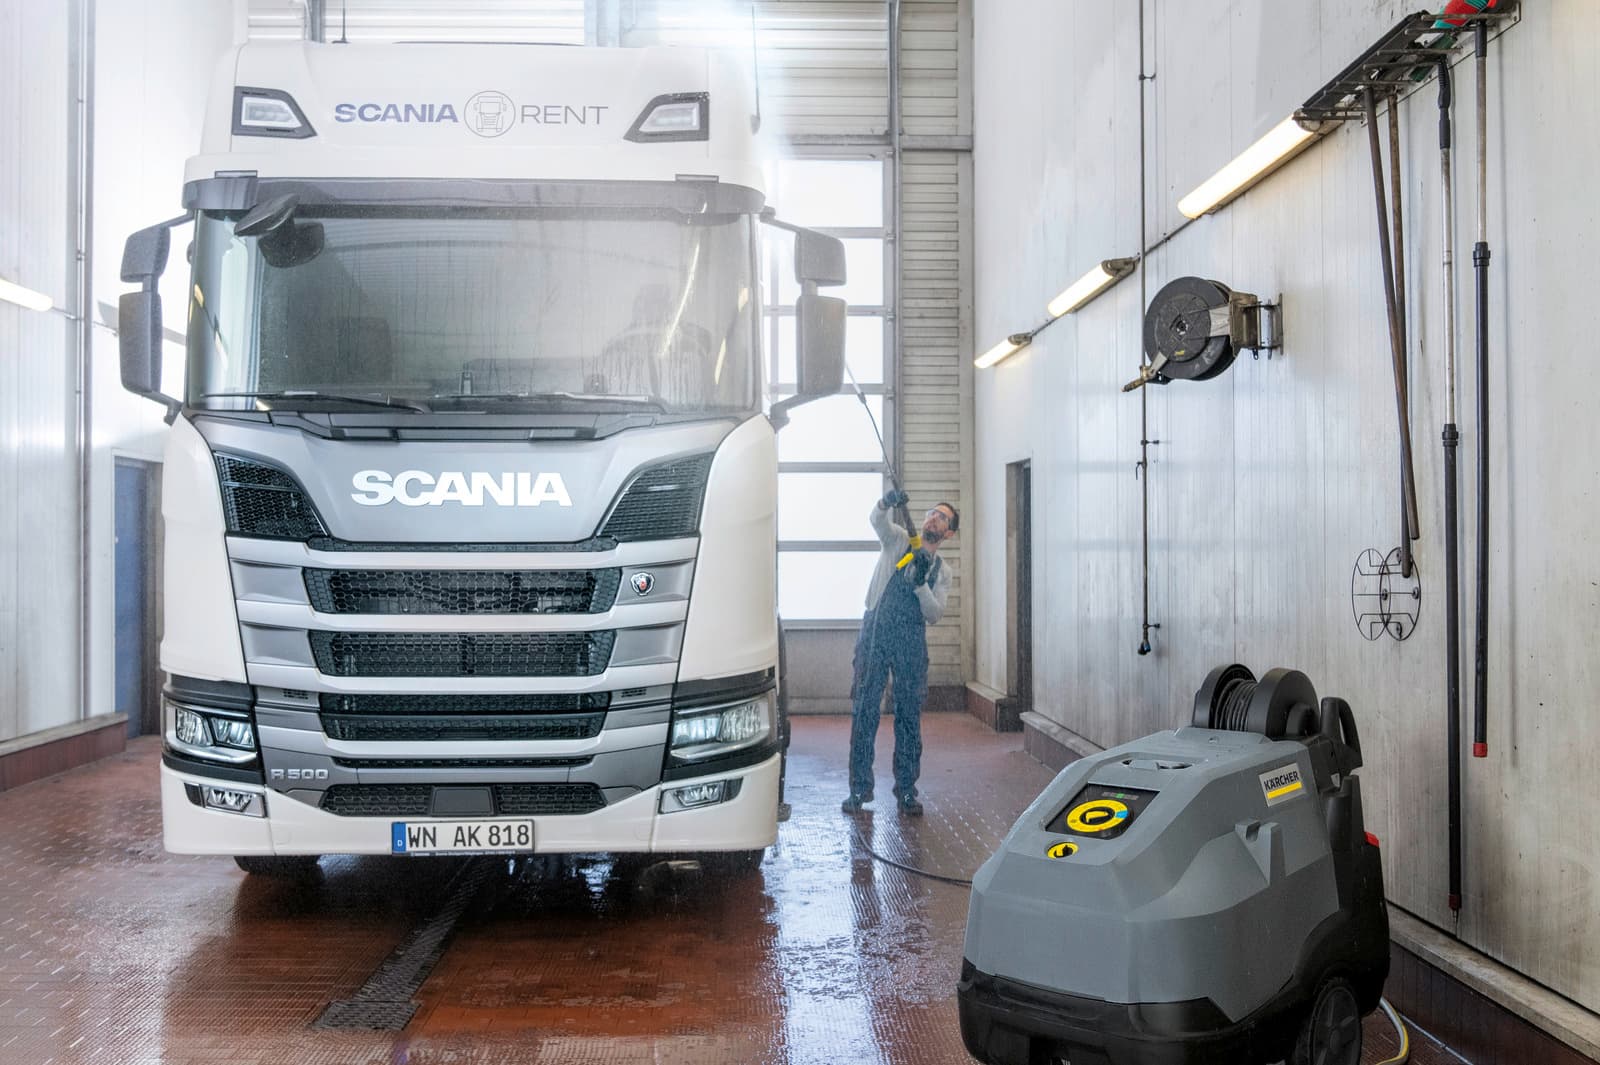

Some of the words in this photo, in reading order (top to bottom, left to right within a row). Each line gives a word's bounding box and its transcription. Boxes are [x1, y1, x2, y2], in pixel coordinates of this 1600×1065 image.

[334, 103, 459, 123] SCANIA
[520, 104, 608, 125] RENT
[351, 470, 573, 507] SCANIA
[1263, 770, 1299, 790] KÄRCHER
[407, 826, 437, 848] WN
[453, 825, 482, 847] AK
[488, 824, 530, 847] 818
